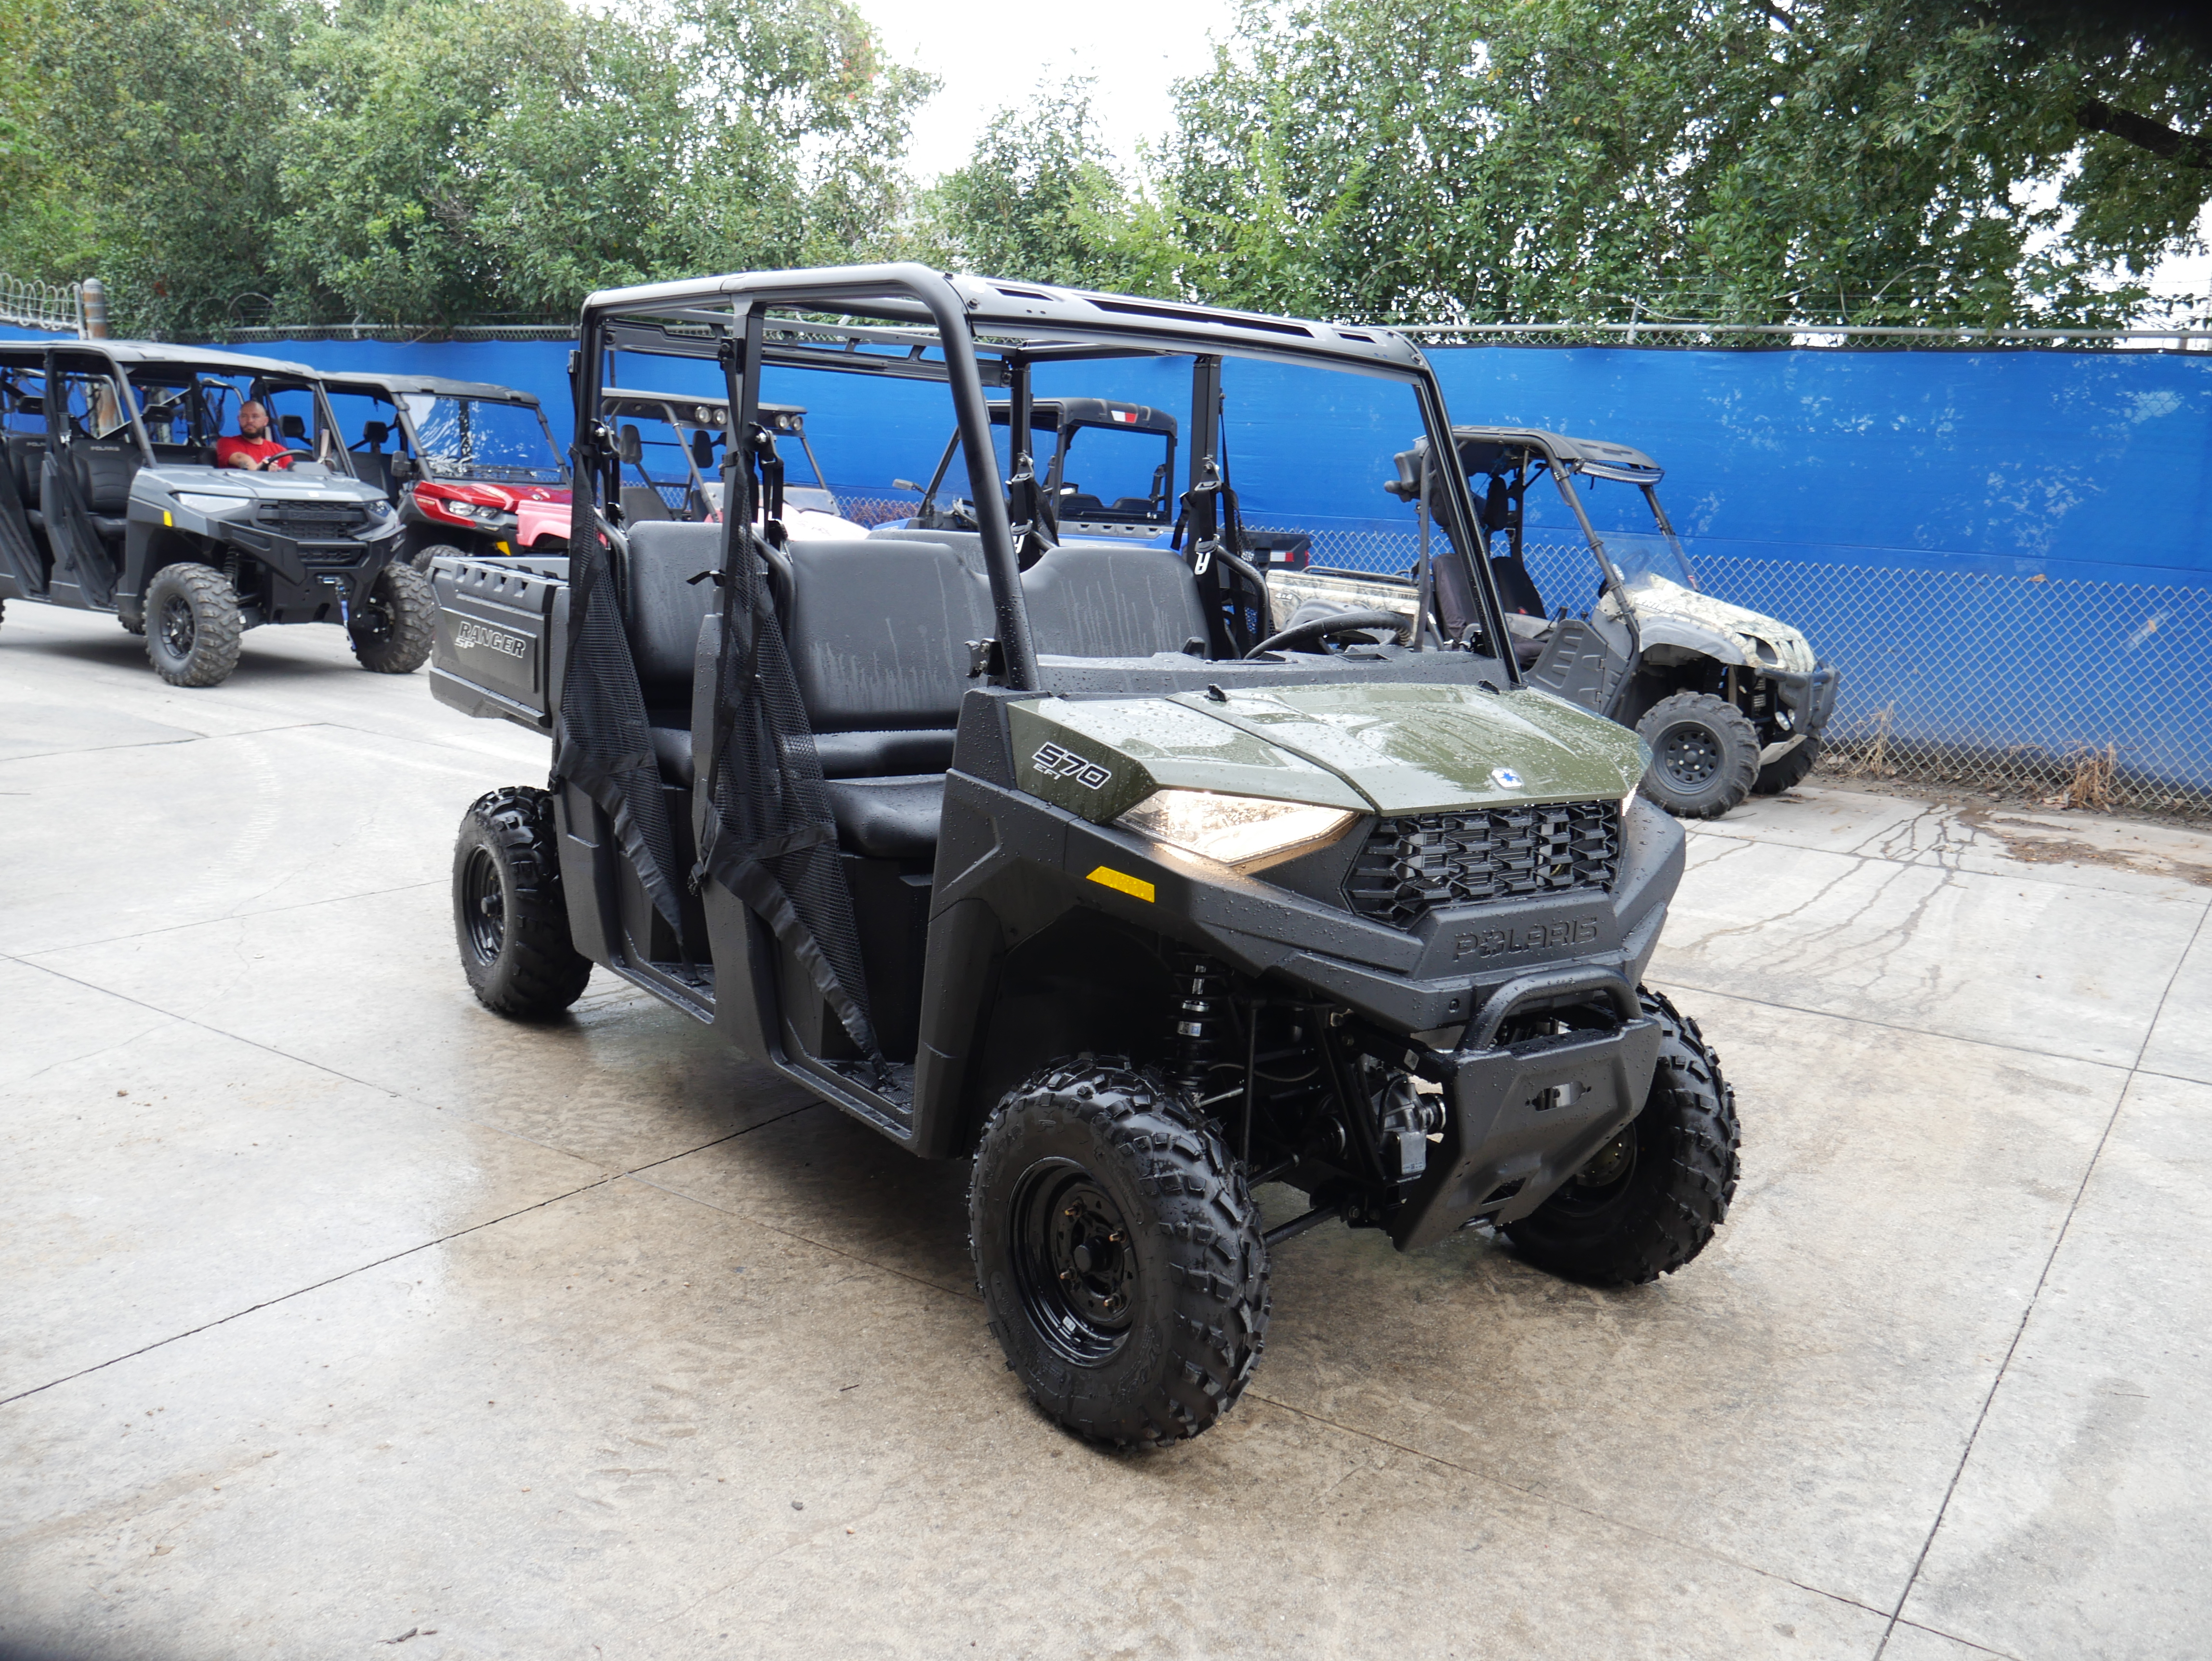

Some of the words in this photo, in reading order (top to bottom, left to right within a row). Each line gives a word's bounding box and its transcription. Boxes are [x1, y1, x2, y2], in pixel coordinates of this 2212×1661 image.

[454, 637, 475, 649] SP
[459, 620, 526, 658] RANGER
[1031, 741, 1112, 790] 570
[1033, 763, 1062, 780] EFI
[1452, 916, 1597, 962] POLARIS
